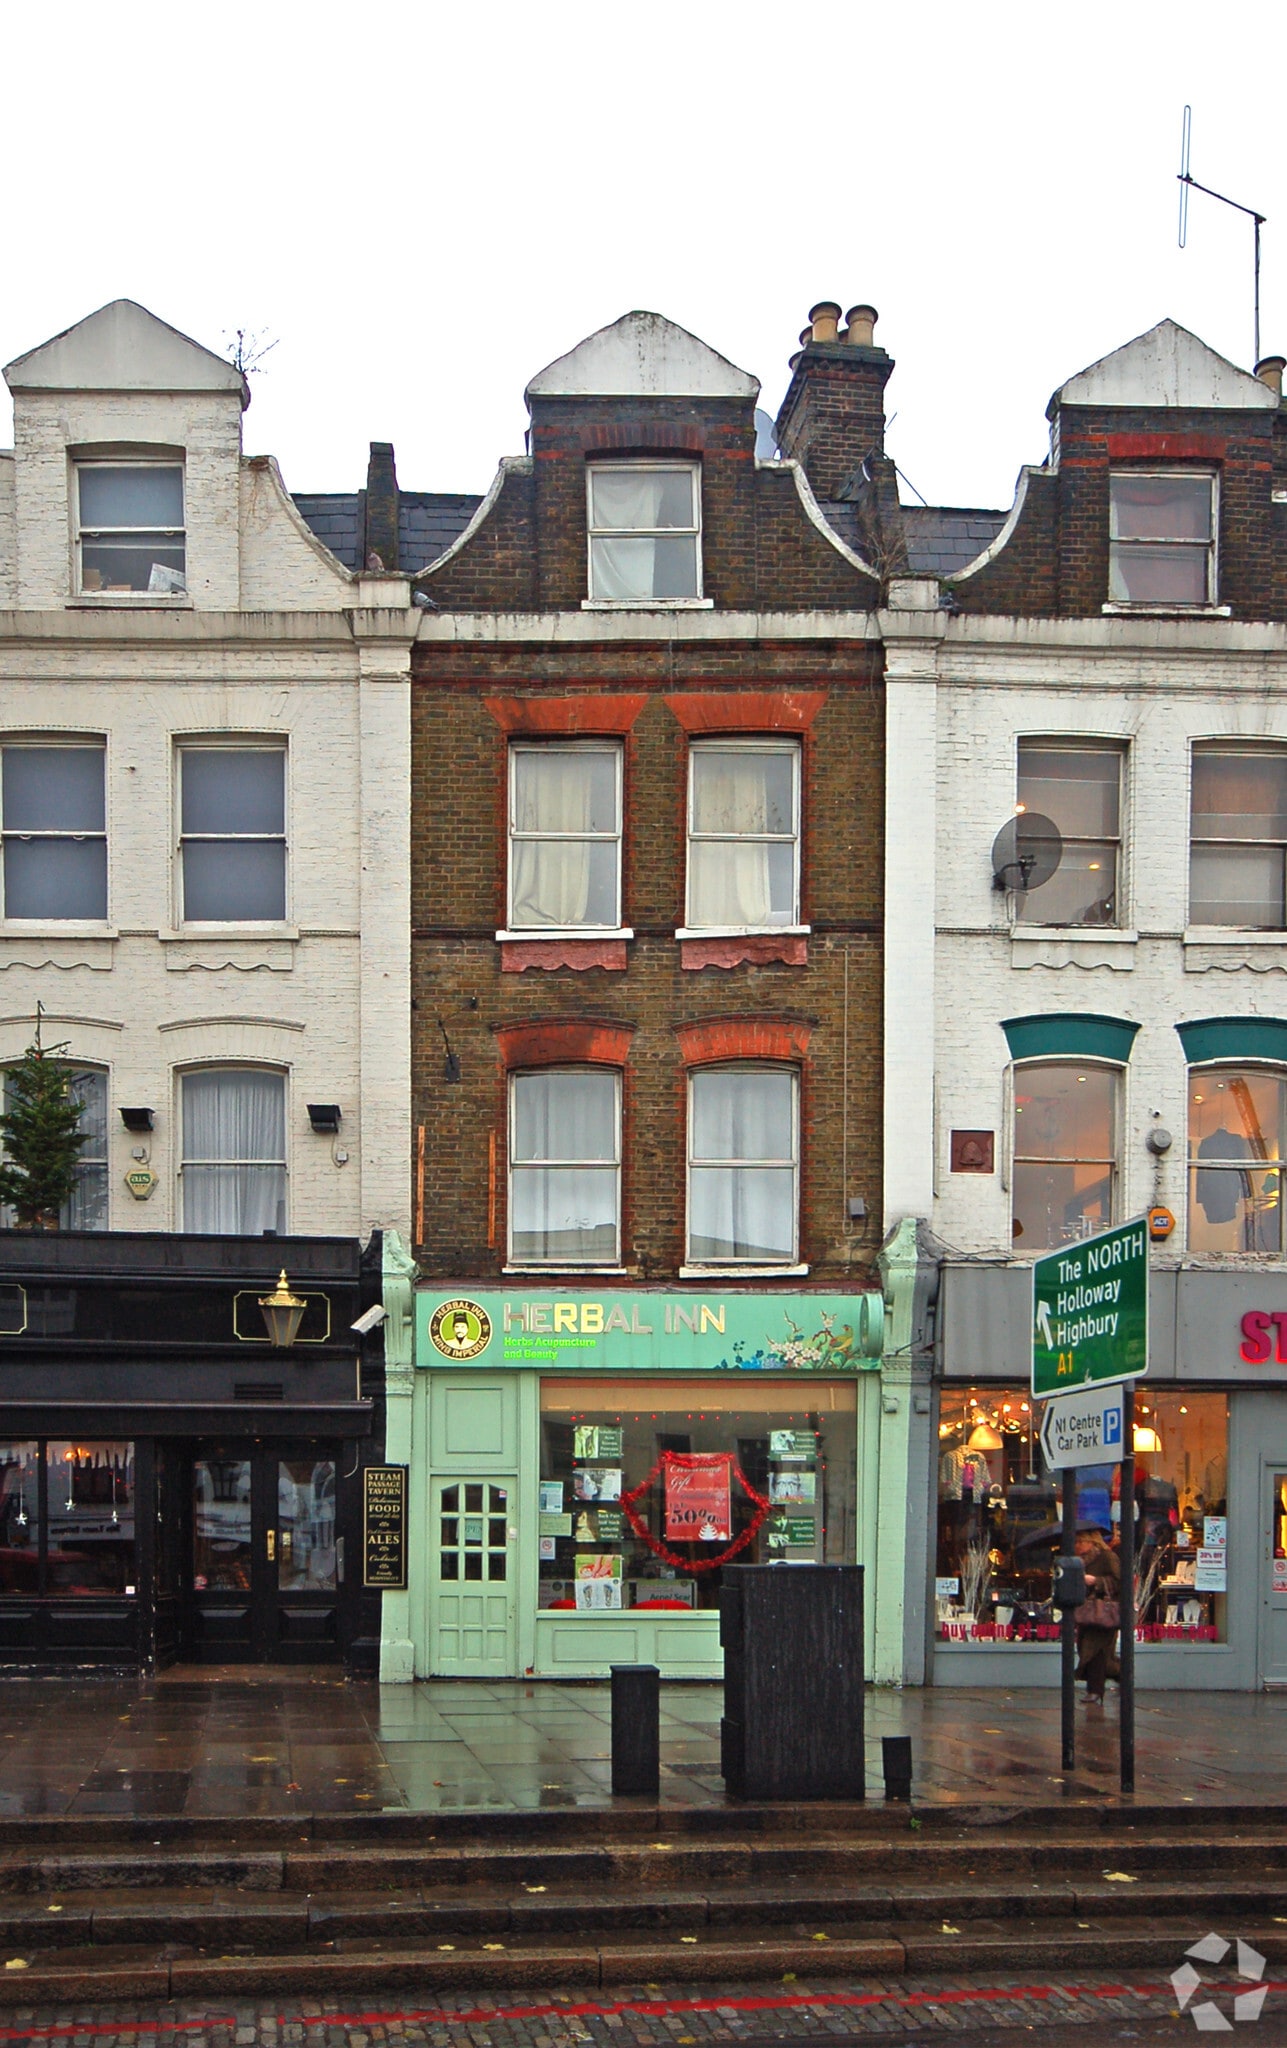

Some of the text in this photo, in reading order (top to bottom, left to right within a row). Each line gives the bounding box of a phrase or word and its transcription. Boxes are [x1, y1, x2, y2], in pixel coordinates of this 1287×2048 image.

[1058, 1231, 1143, 1284] The NORTH
[1057, 1279, 1121, 1315] Holloway
[436, 1301, 486, 1320] HERBAL INN
[503, 1302, 725, 1335] HERBAL INN
[1057, 1312, 1119, 1347] Highbury
[452, 1336, 489, 1357] IMPERIAL
[503, 1337, 597, 1348] Herbs Acupuncture
[503, 1349, 558, 1360] and Beauty
[1057, 1350, 1073, 1376] A1
[1055, 1417, 1066, 1434] N1
[1069, 1413, 1102, 1432] Centre
[1057, 1432, 1098, 1451] Car Park
[368, 1473, 401, 1481] STEAM
[671, 1473, 694, 1493] Gift
[369, 1504, 401, 1513] FOOD
[368, 1535, 400, 1545] ALES
[941, 1621, 966, 1639] buy
